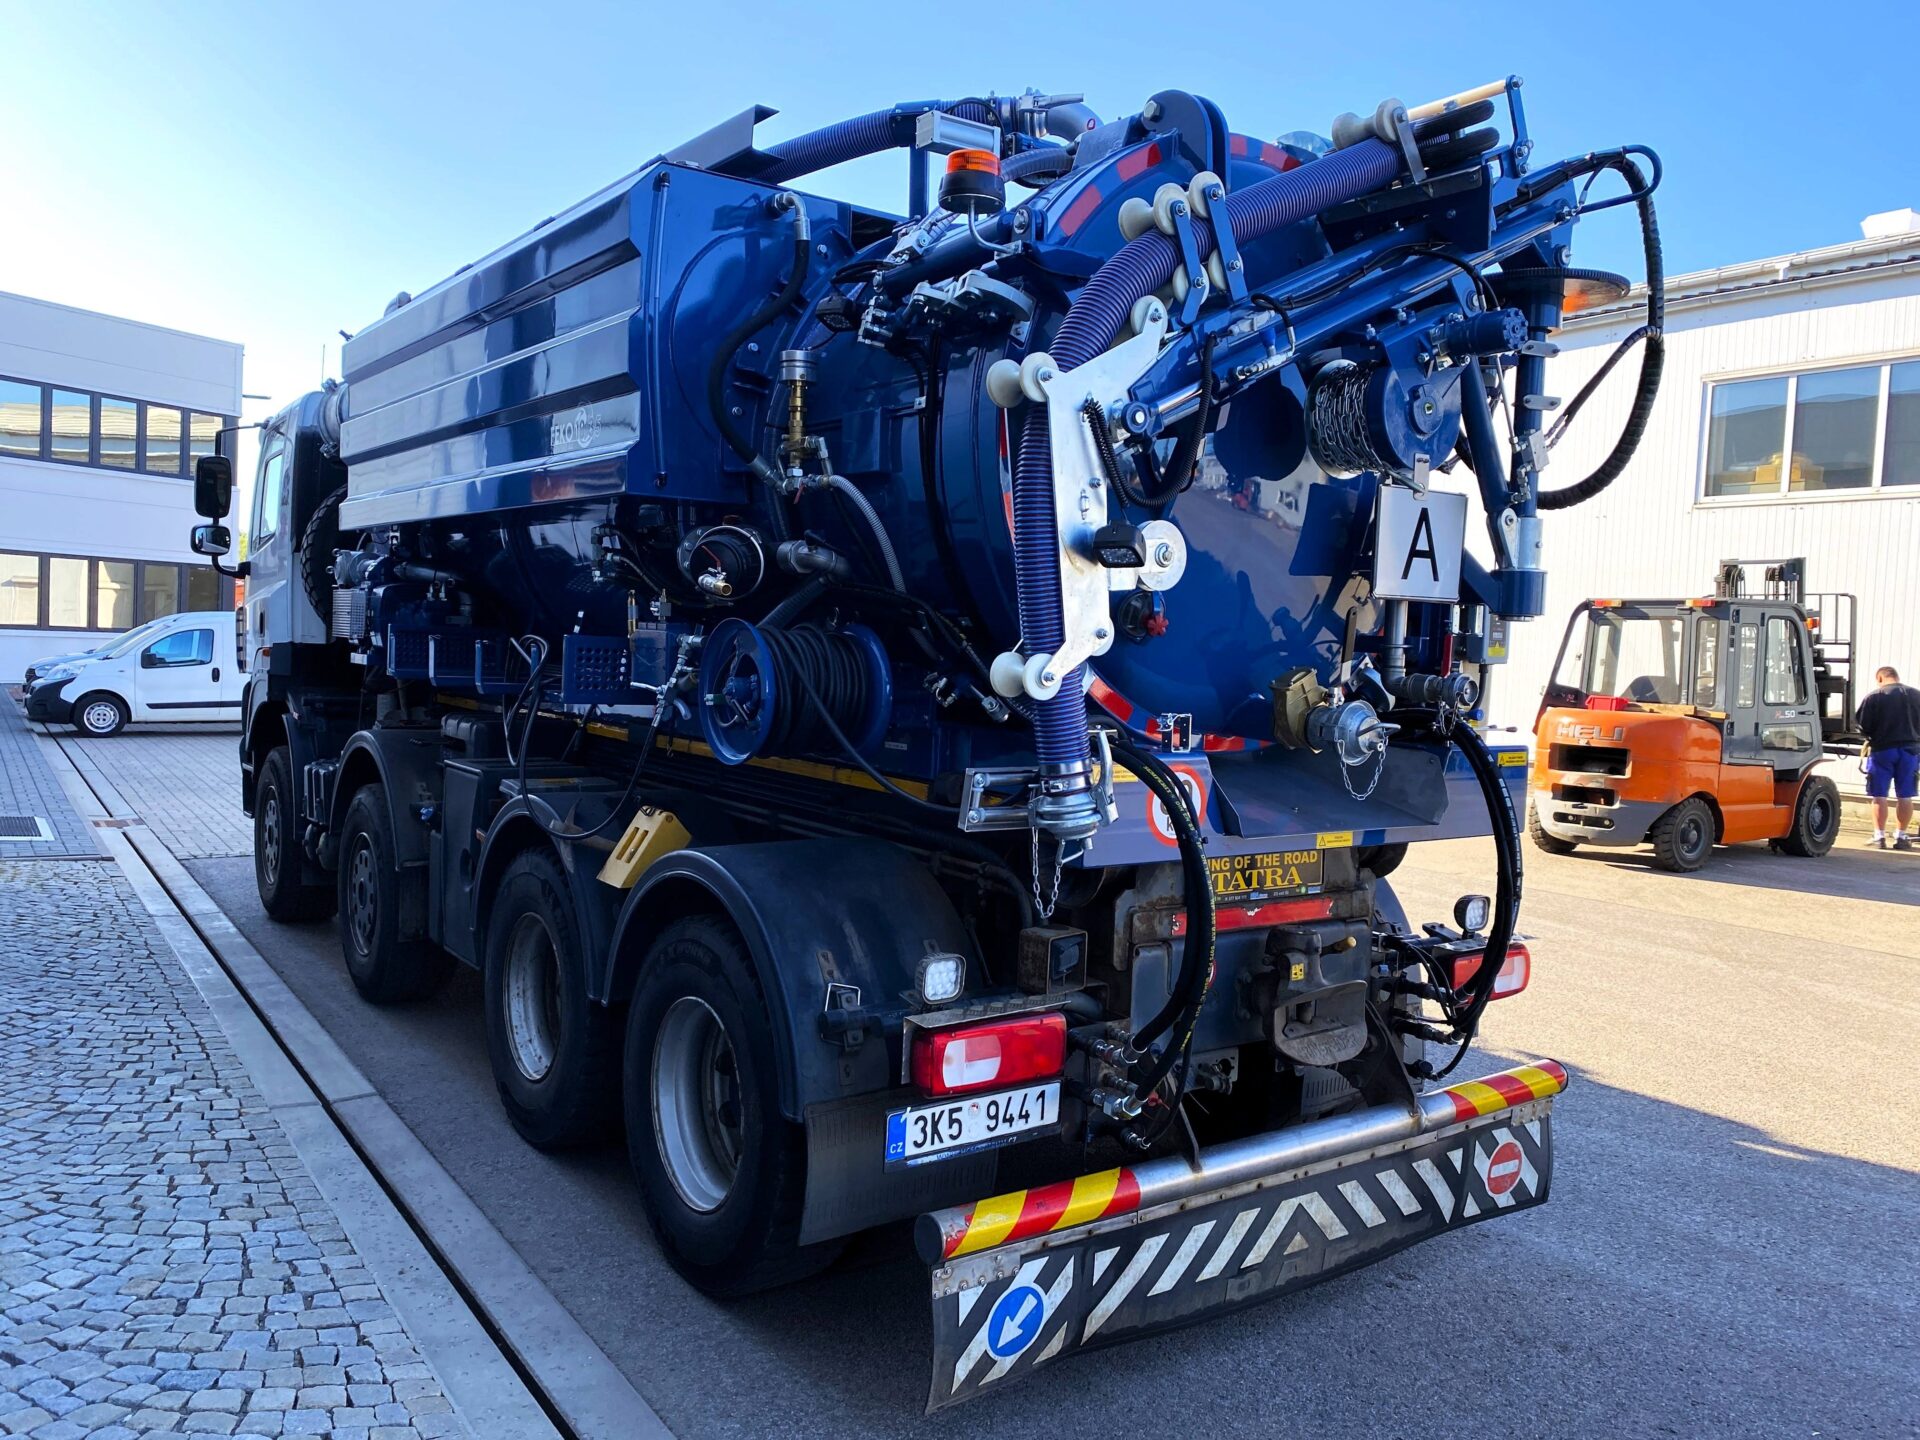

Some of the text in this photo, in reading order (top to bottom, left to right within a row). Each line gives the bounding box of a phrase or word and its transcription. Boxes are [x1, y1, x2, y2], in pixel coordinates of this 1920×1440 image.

[550, 421, 573, 447] FEKO
[1401, 507, 1440, 582] A
[1557, 723, 1625, 742] HELI
[1206, 851, 1318, 871] ING OF THE ROAD
[1211, 866, 1303, 892] TATRA
[912, 1089, 1046, 1149] 3K5 9441
[890, 1141, 903, 1154] CZ
